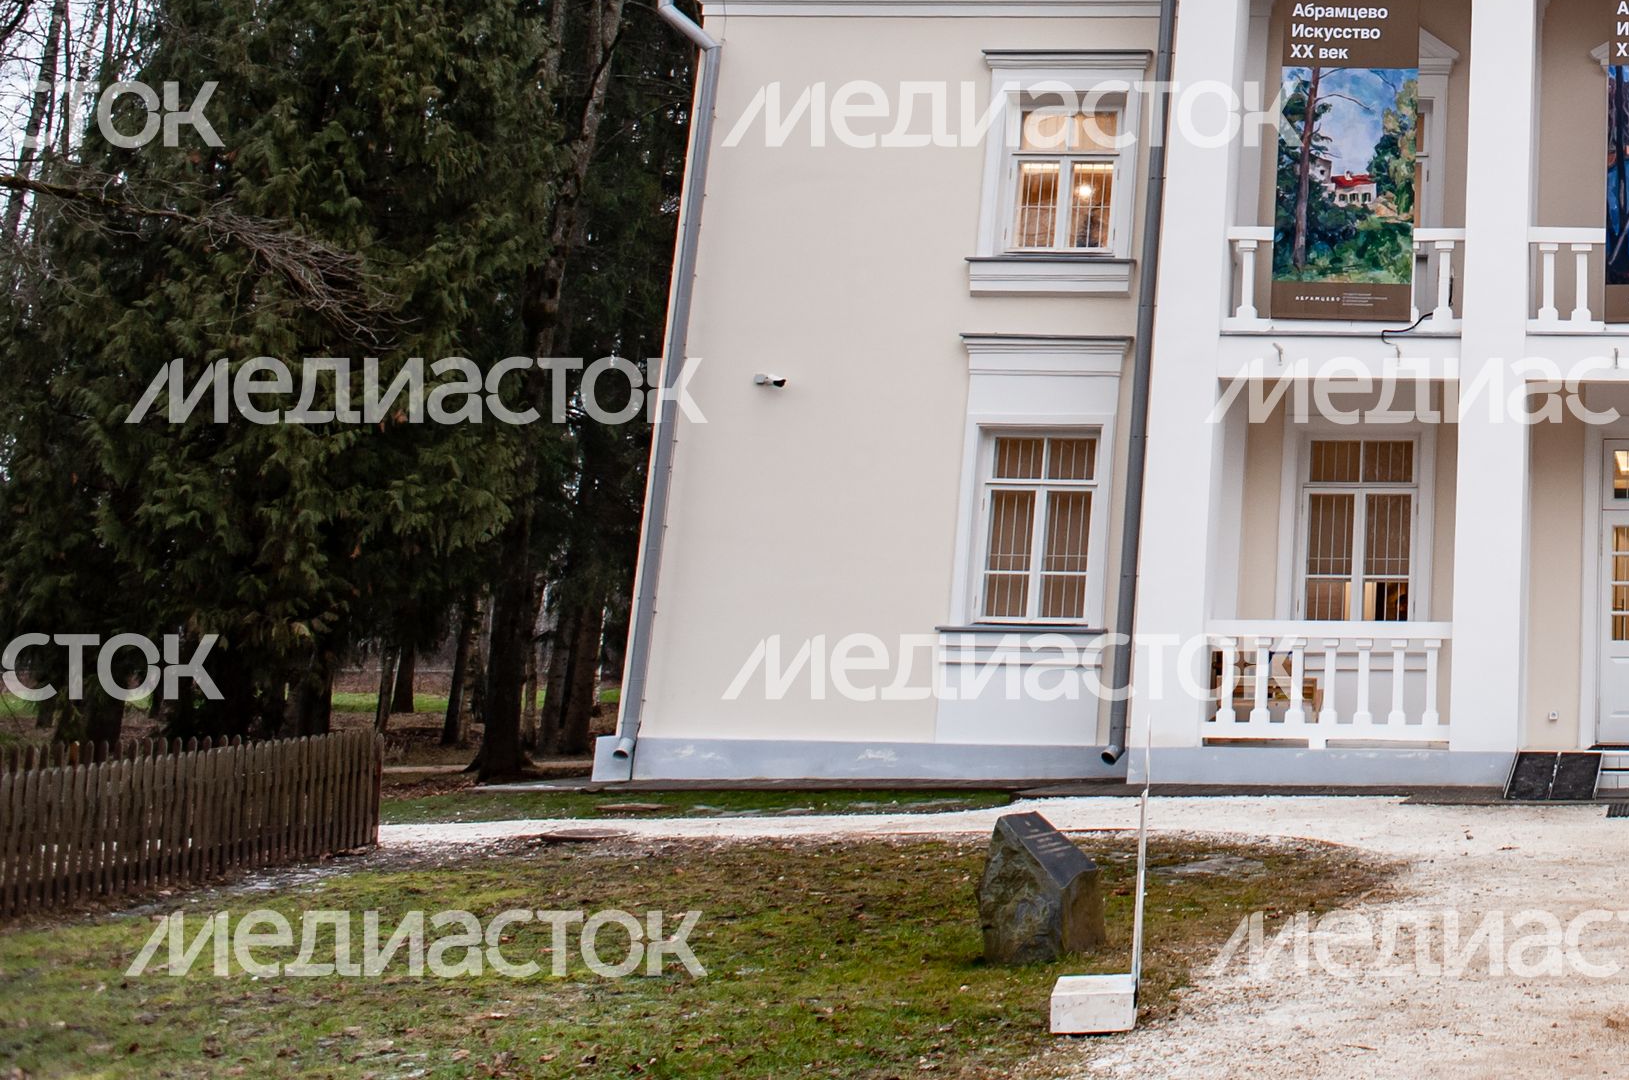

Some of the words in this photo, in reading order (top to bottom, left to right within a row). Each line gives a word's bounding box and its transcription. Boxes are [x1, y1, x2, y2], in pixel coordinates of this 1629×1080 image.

[1292, 2, 1389, 21] Абрамцево
[1291, 23, 1381, 42] Искусство
[1318, 47, 1349, 60] век
